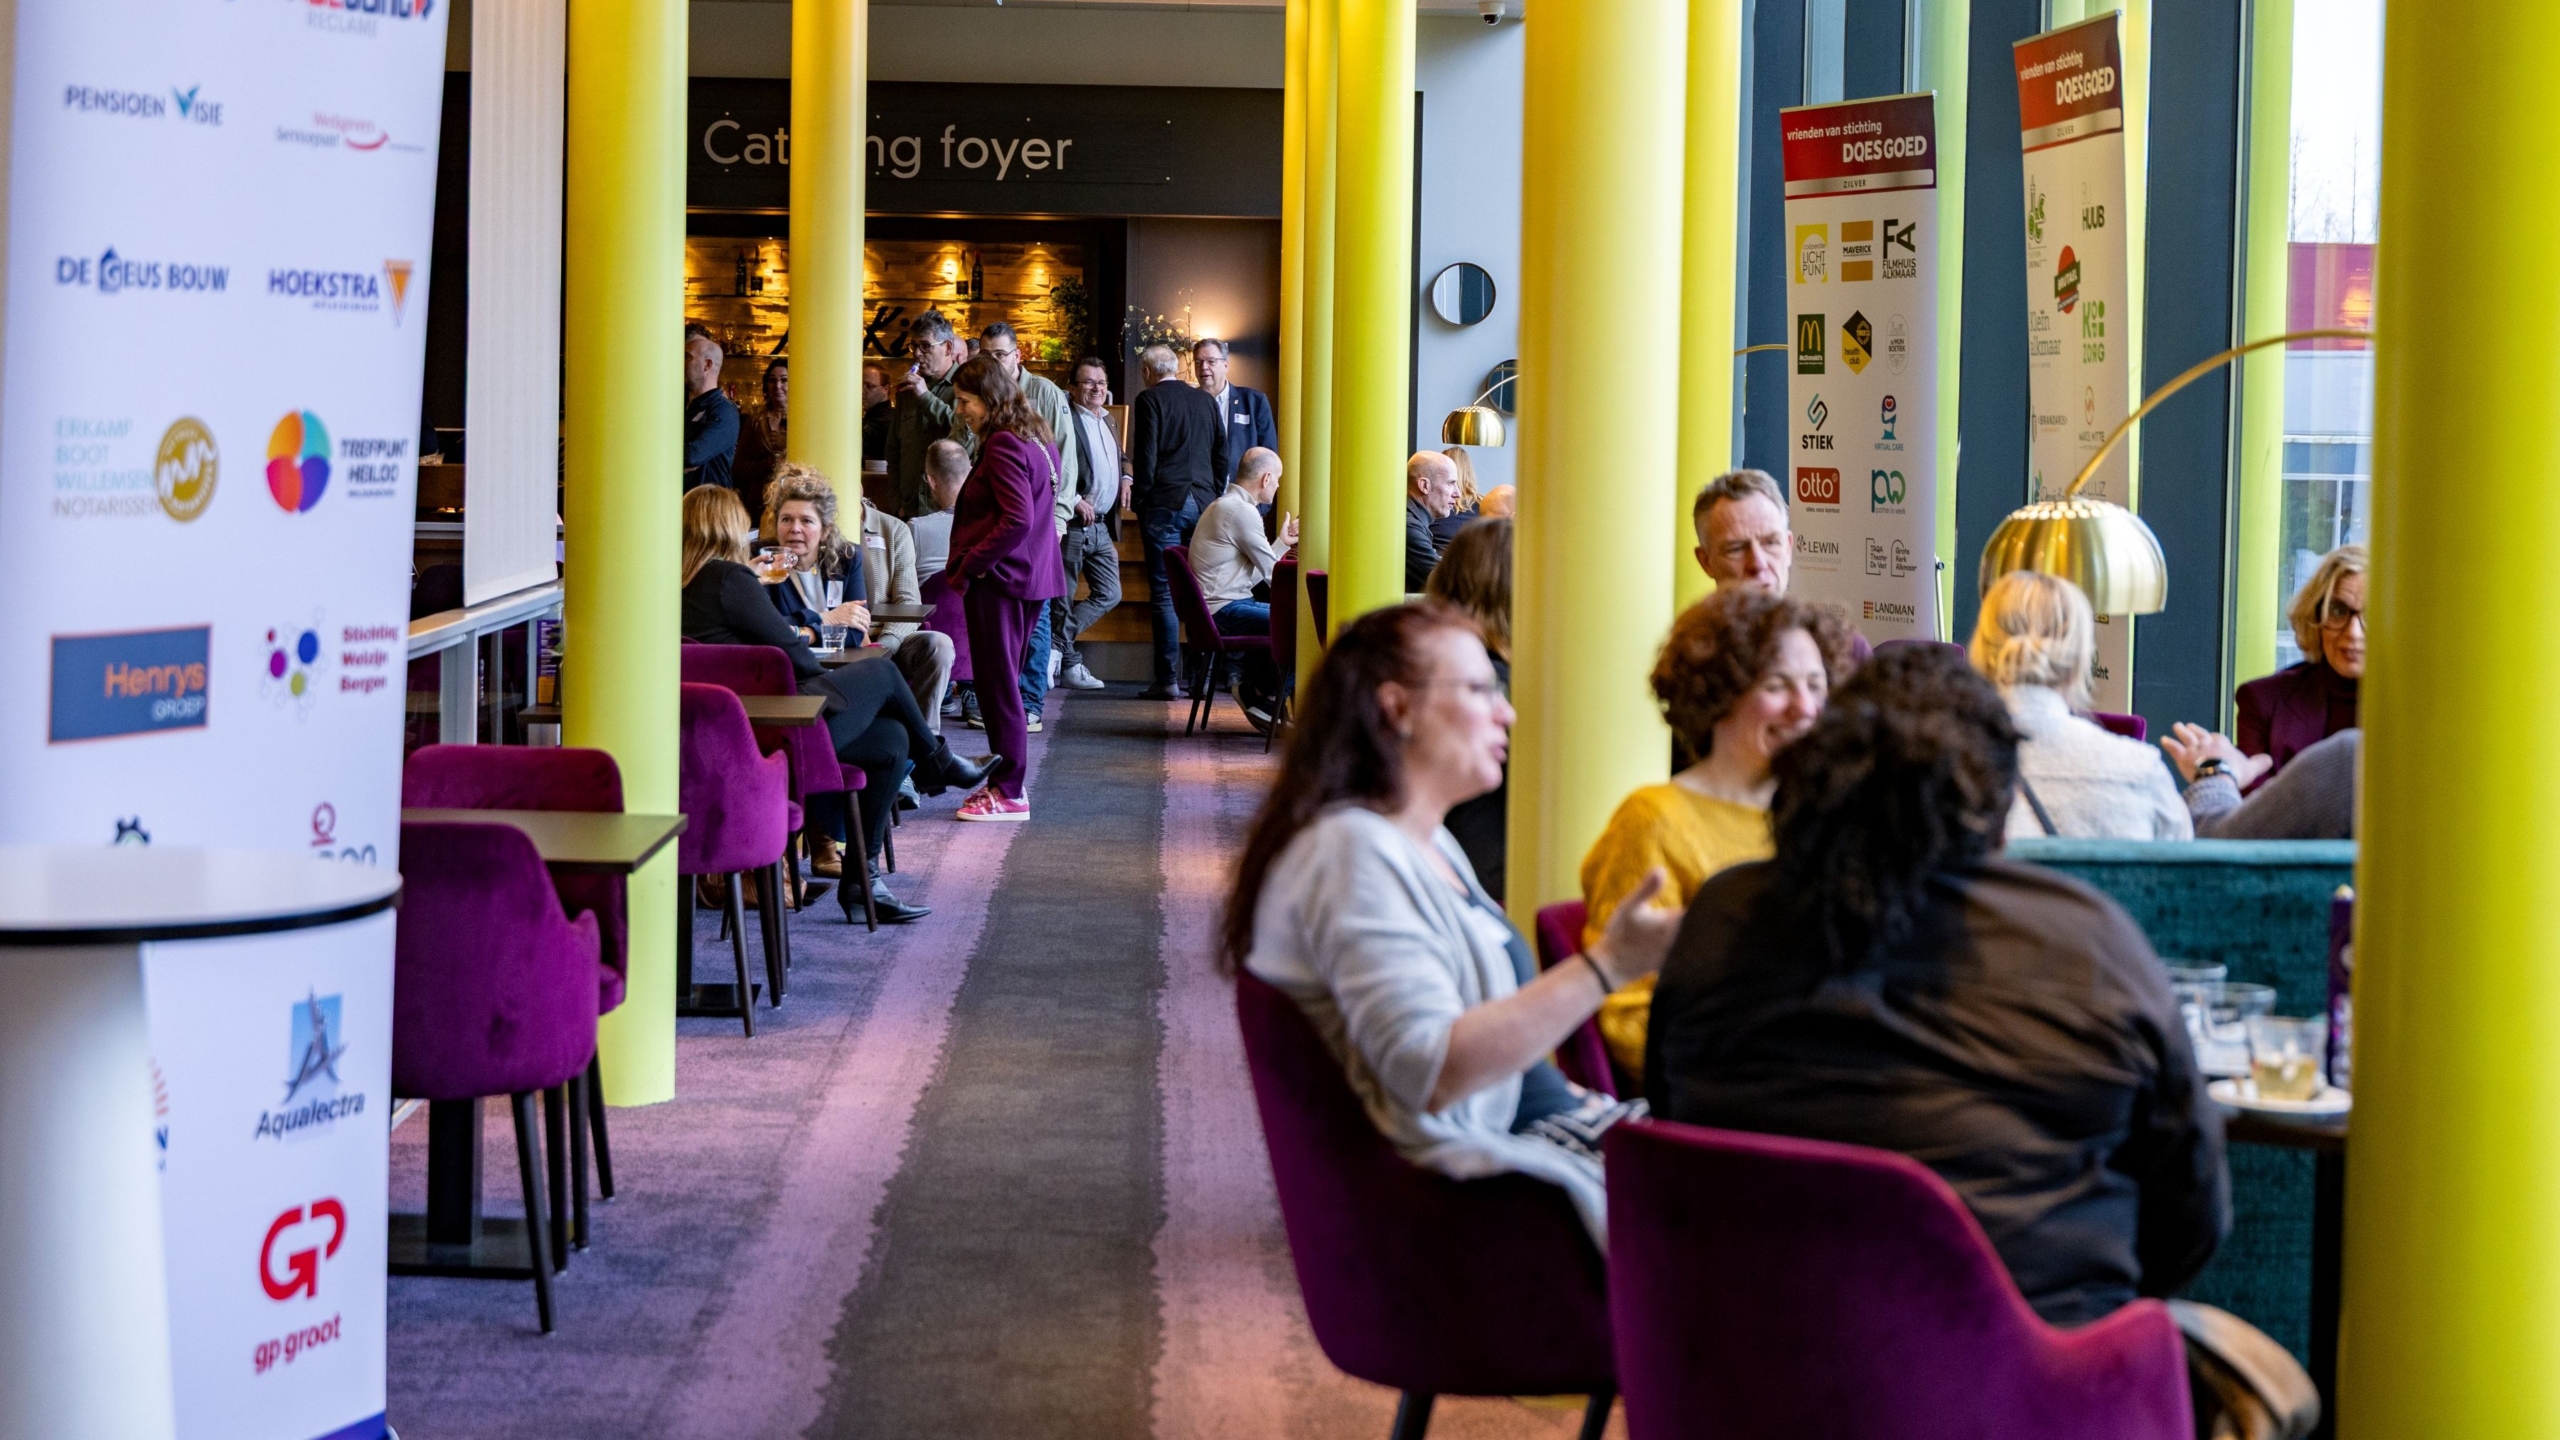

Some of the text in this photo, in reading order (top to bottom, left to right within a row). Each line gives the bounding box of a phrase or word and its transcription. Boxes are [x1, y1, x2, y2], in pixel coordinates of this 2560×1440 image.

[66, 85, 165, 117] PENSIOEN
[1787, 120, 1882, 141] vrienden van stichting
[704, 119, 1073, 181] Catng foyer
[1843, 179, 1867, 189] ZILVER
[1843, 245, 1872, 255] MAVERICK
[1802, 251, 1826, 263] LICHT
[1882, 258, 1917, 269] FILMHUIS
[57, 257, 91, 285] DE
[167, 262, 229, 292] BOUW
[1803, 263, 1826, 276] PUNT
[1882, 268, 1917, 279] ALKMAAR
[268, 268, 380, 301] HOEKSTRA
[1844, 347, 1861, 356] health
[1849, 357, 1861, 365] club
[1802, 434, 1834, 450] STIEK
[1874, 443, 1904, 451] VIRTUAL CARE
[54, 495, 161, 518] NOTARISSEN
[1808, 541, 1839, 554] LEWIN
[1895, 547, 1910, 555] Grote
[1878, 561, 1887, 569] Vest
[1896, 555, 1907, 563] Kerk
[1896, 563, 1917, 572] Alkmaar
[1875, 602, 1915, 616] LANDMAN
[105, 662, 206, 697] Henrys
[152, 697, 205, 721] GROEP
[255, 1091, 366, 1139] Aqualectra
[254, 1312, 342, 1374] gp groot
